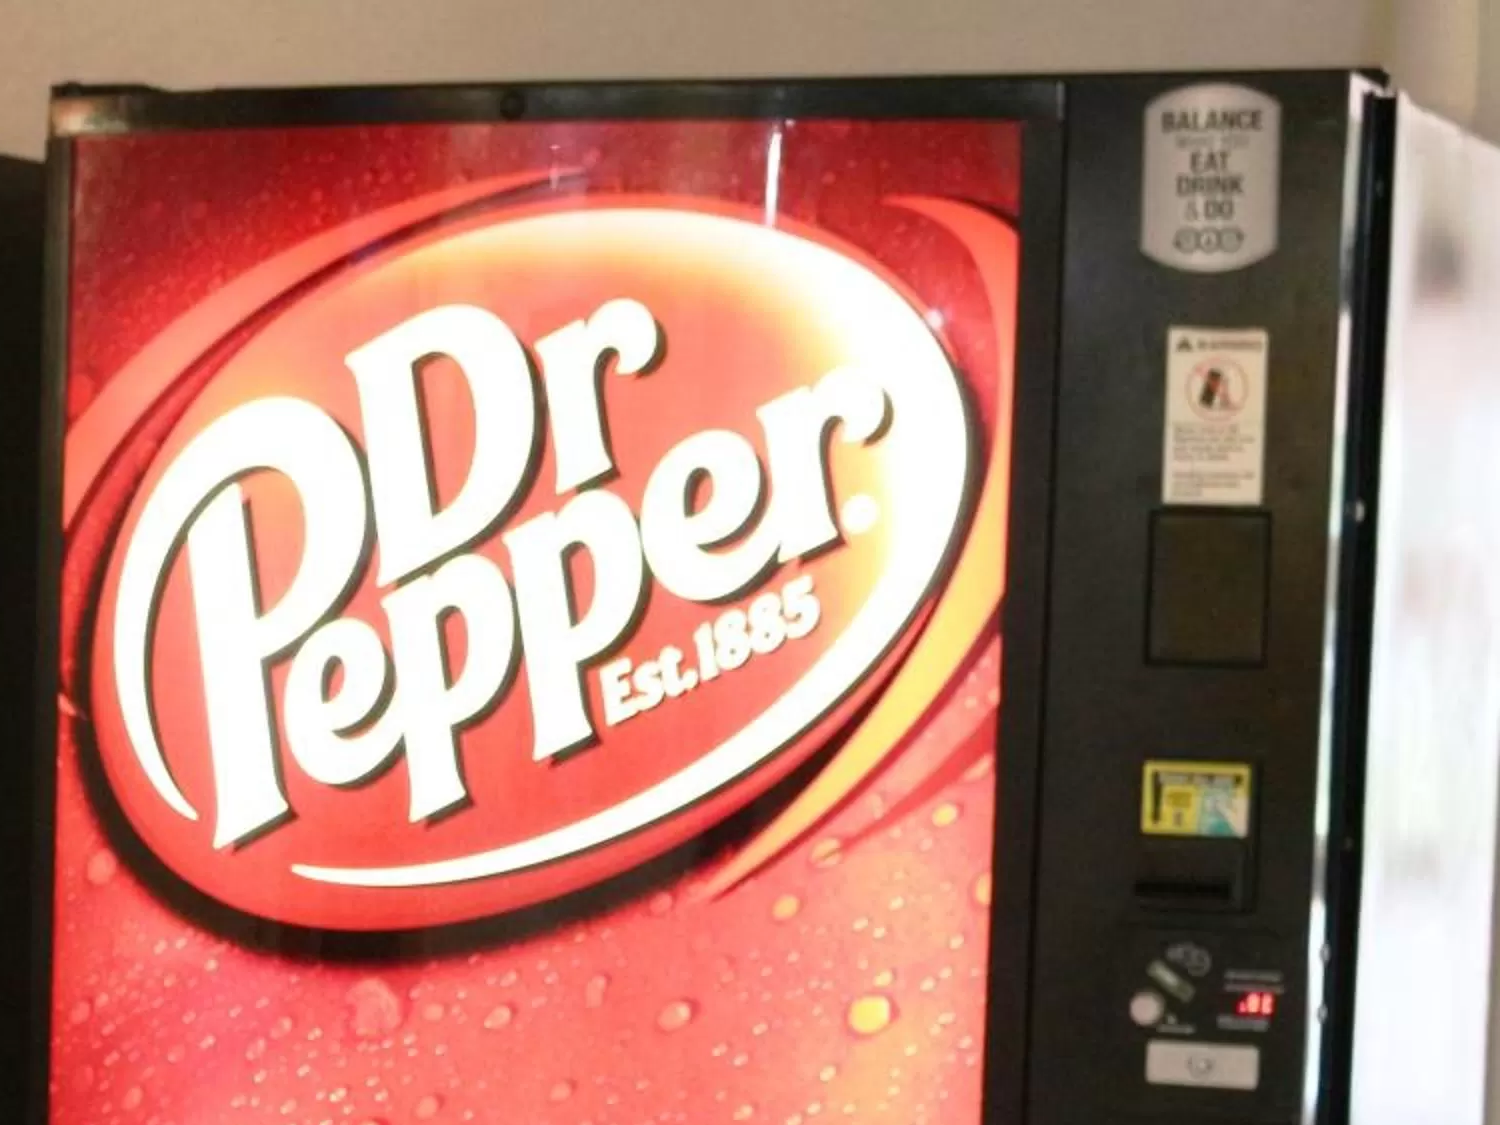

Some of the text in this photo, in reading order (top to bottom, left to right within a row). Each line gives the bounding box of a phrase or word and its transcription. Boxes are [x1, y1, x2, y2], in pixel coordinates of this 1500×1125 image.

[1161, 110, 1263, 132] BALANCE
[1190, 152, 1229, 173] EAT
[1176, 174, 1244, 197] DRINK
[344, 297, 664, 588] Dr
[114, 368, 894, 851] Pepper
